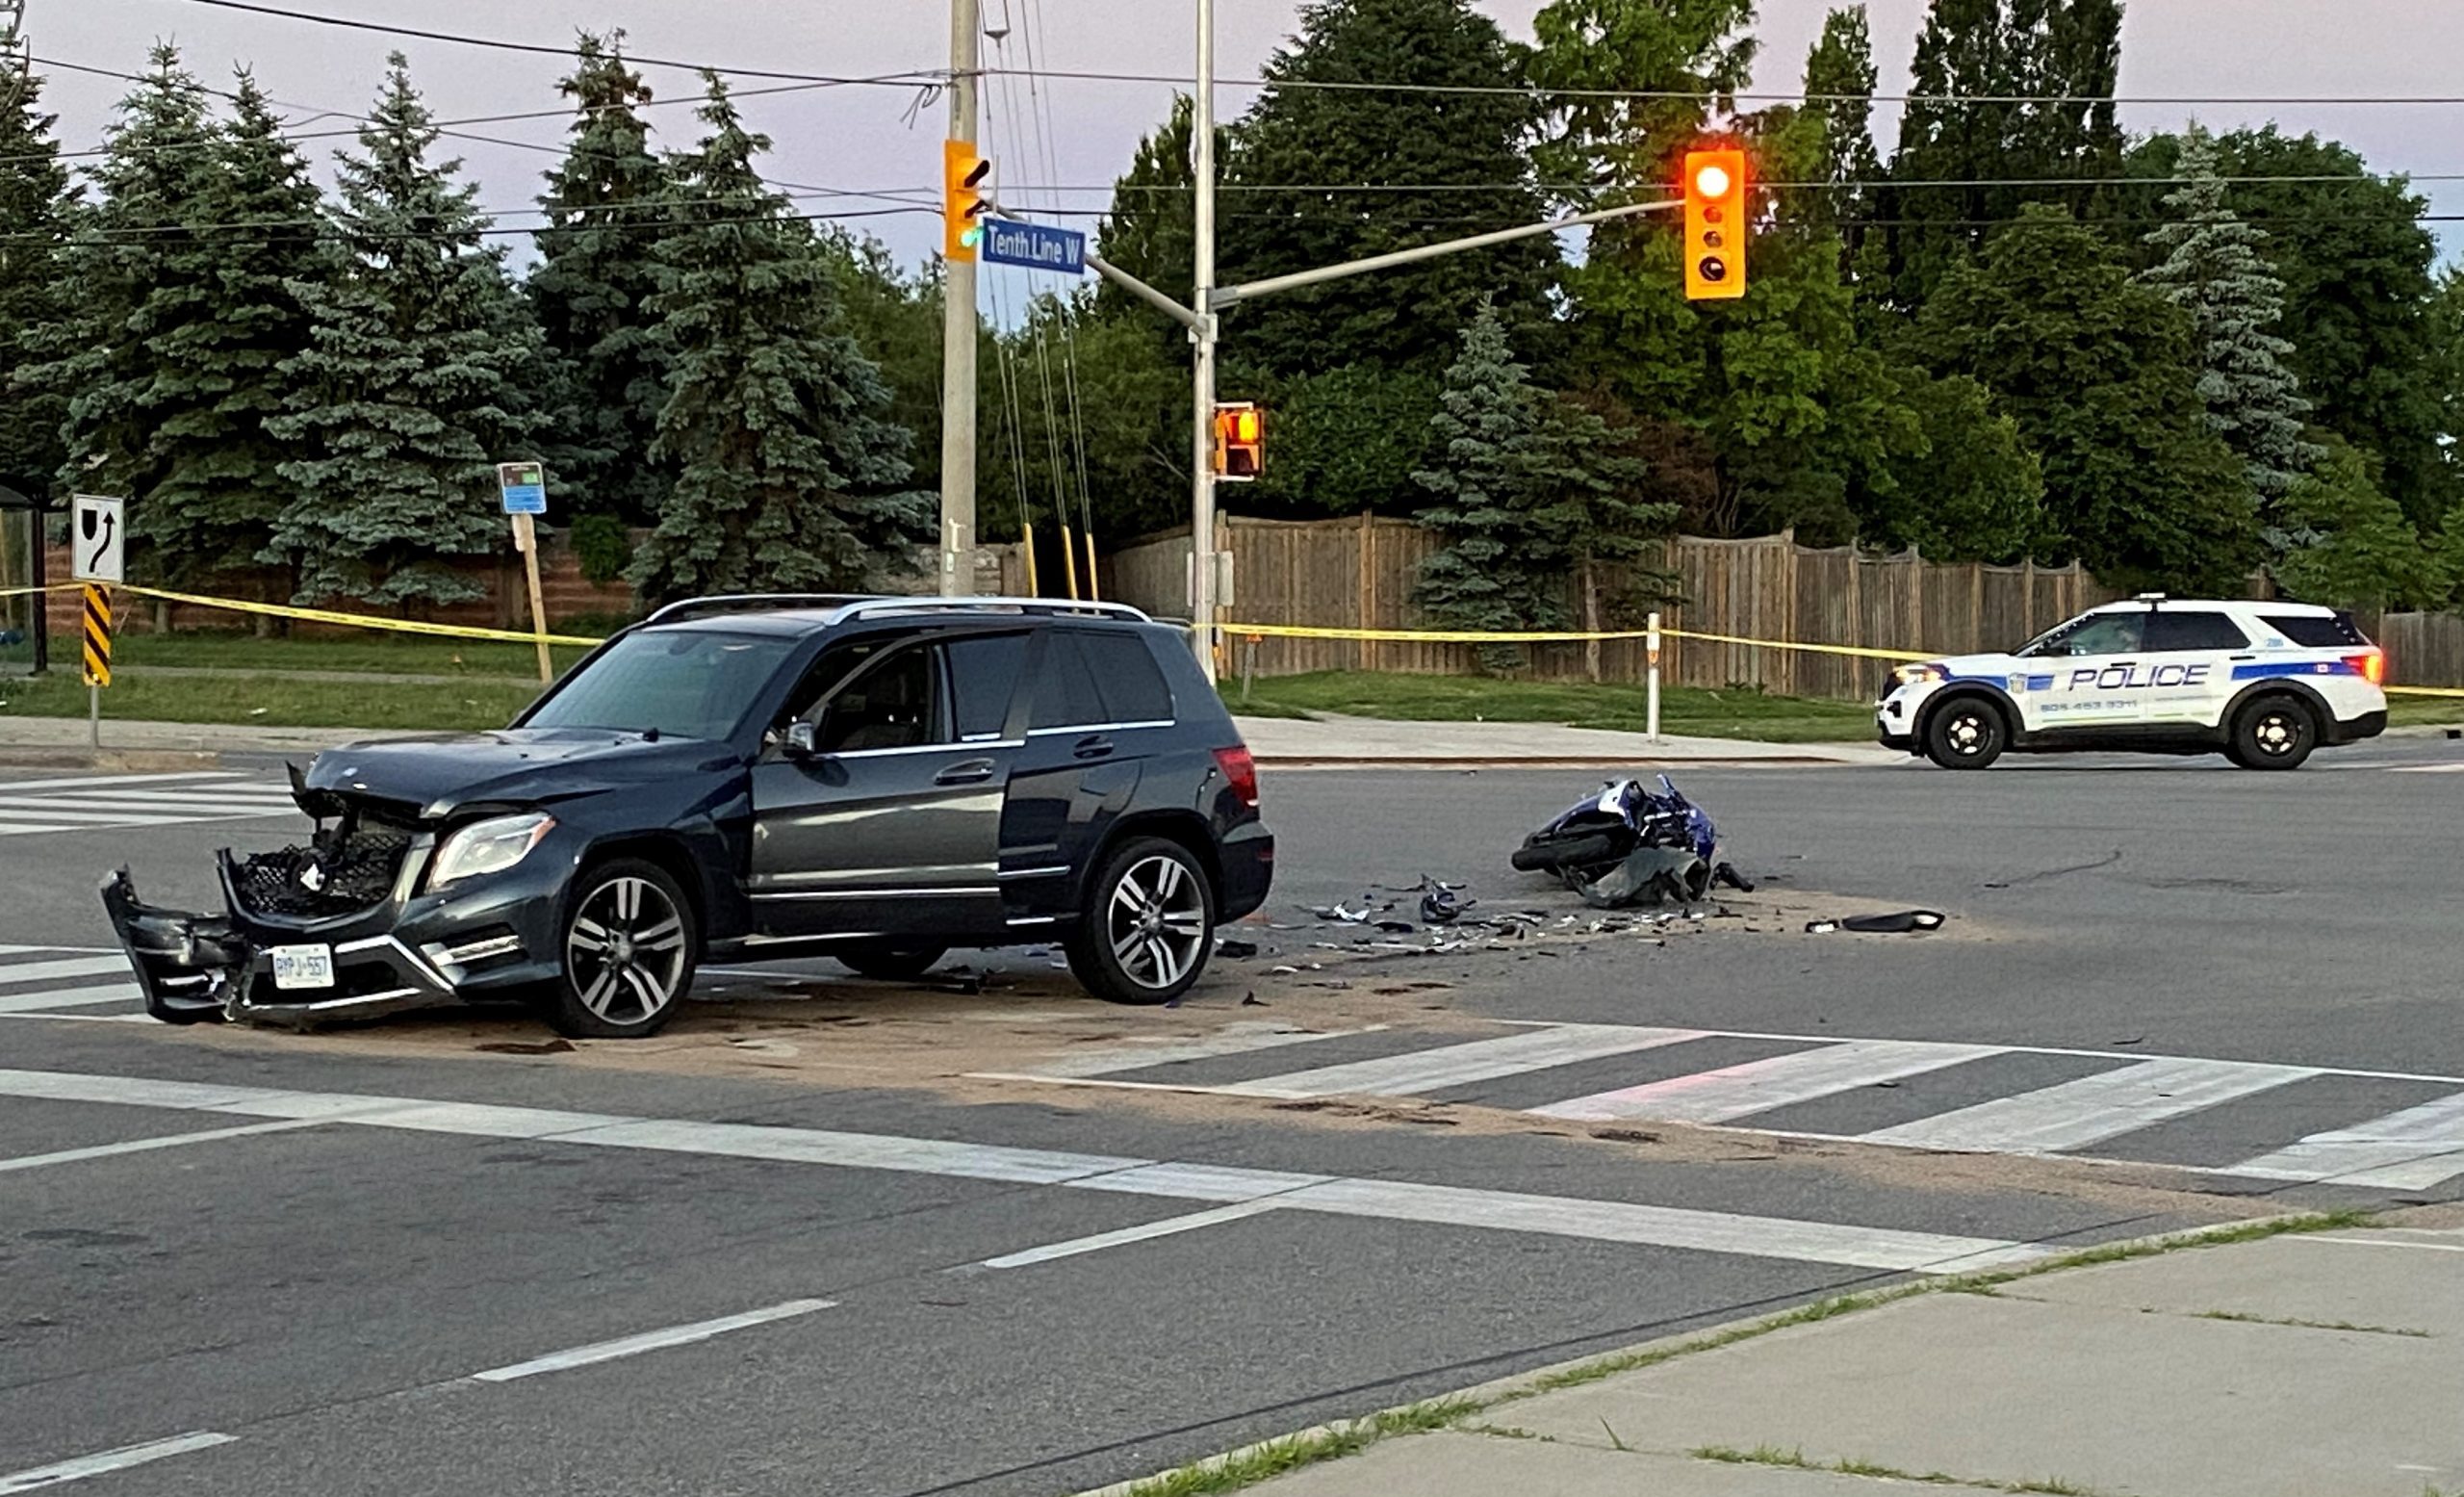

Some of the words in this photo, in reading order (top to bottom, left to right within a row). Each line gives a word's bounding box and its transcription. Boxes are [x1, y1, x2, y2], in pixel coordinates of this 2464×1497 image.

[988, 224, 1029, 259] Tenth
[1032, 232, 1063, 264] Line
[1065, 237, 1081, 265] W
[2068, 664, 2211, 691] POLICE
